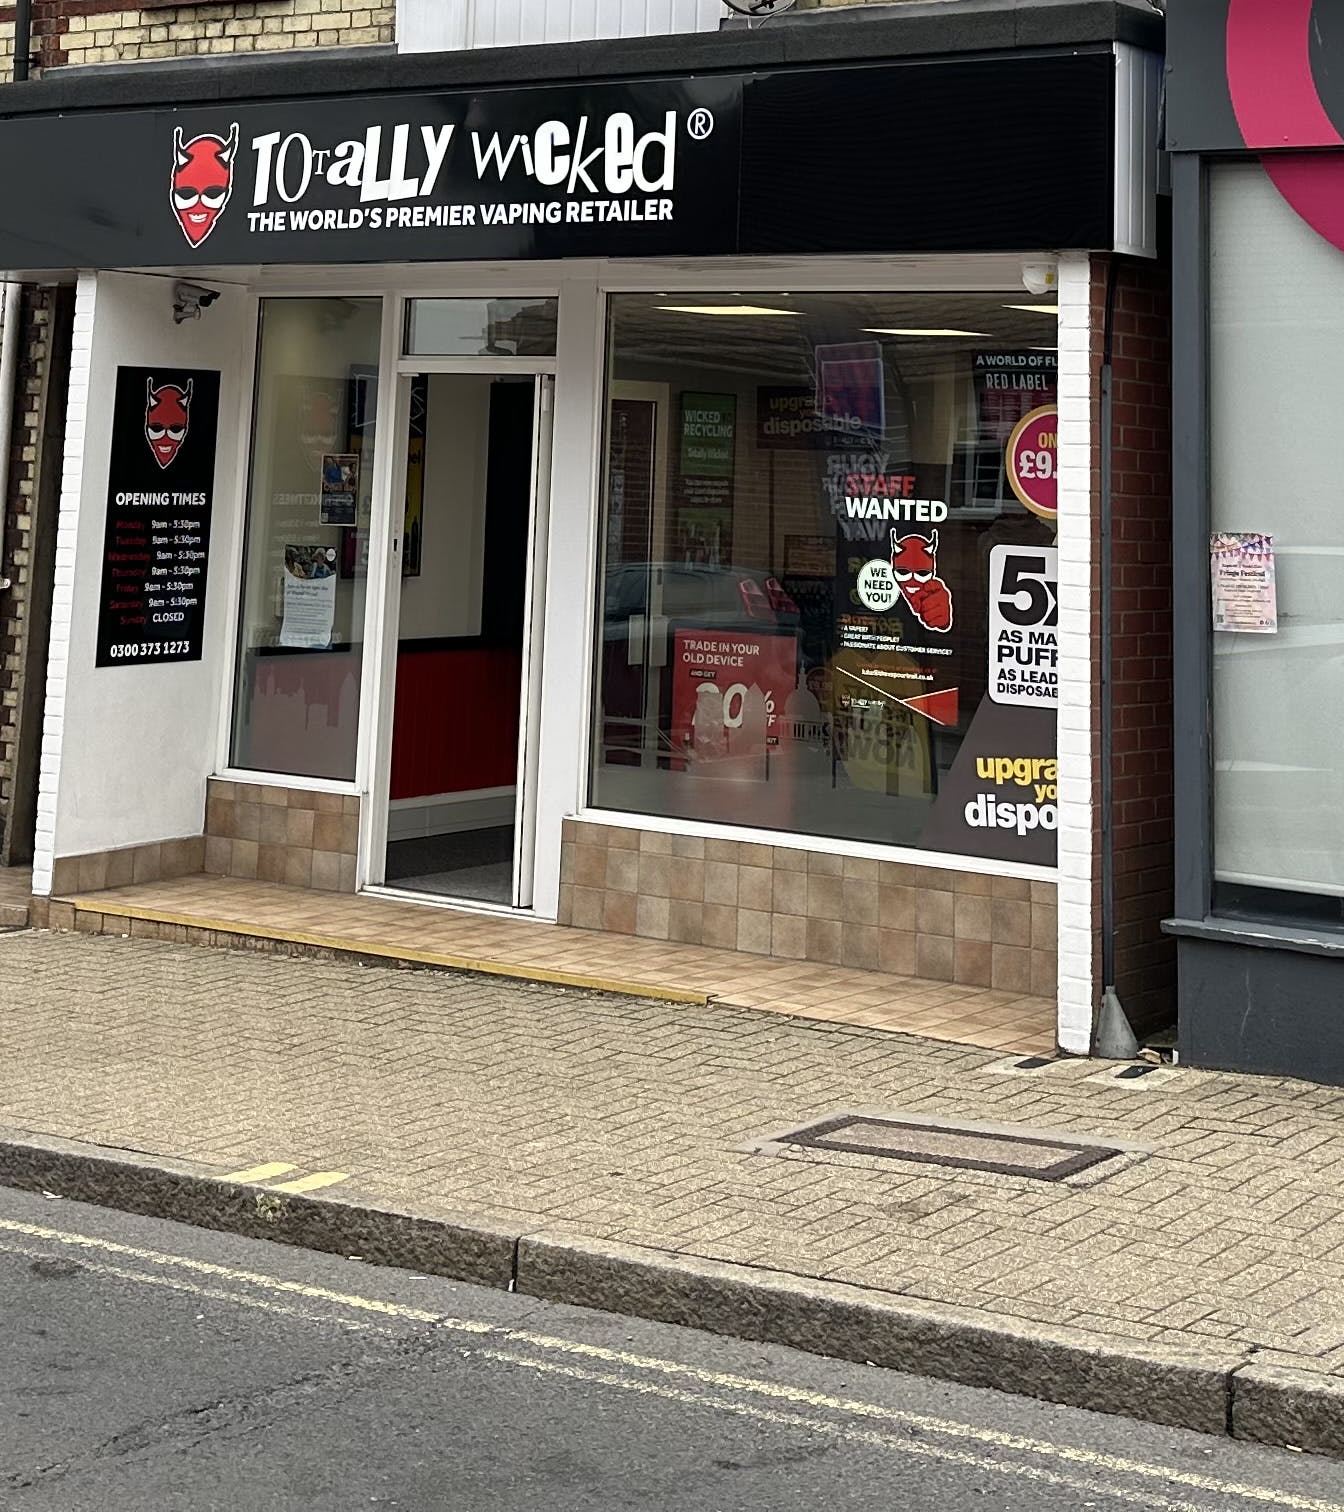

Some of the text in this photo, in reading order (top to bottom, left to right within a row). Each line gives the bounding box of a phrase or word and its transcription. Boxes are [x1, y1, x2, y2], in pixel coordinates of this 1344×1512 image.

[247, 198, 674, 232] THE WORLD'S PREMIER VAPING RETAILER
[976, 355, 985, 366] A
[986, 355, 1027, 366] WORLD
[1028, 356, 1043, 367] OF
[986, 373, 1049, 391] RED LABEL
[685, 410, 720, 424] WICKED
[684, 423, 733, 437] RECYCLING
[845, 473, 916, 497] STAFF
[115, 492, 206, 506] OPENING TIMES
[845, 497, 948, 523] WANTED
[870, 567, 887, 578] WE
[864, 580, 893, 591] NEED
[866, 593, 892, 603] YOU!
[152, 612, 185, 623] CLOSED
[998, 630, 1058, 646] AS MA
[110, 641, 190, 658] 0300 373 1273
[684, 640, 760, 655] TRADE IN YOUR
[683, 653, 744, 667] OLD DEVICE
[998, 668, 1017, 681] AS
